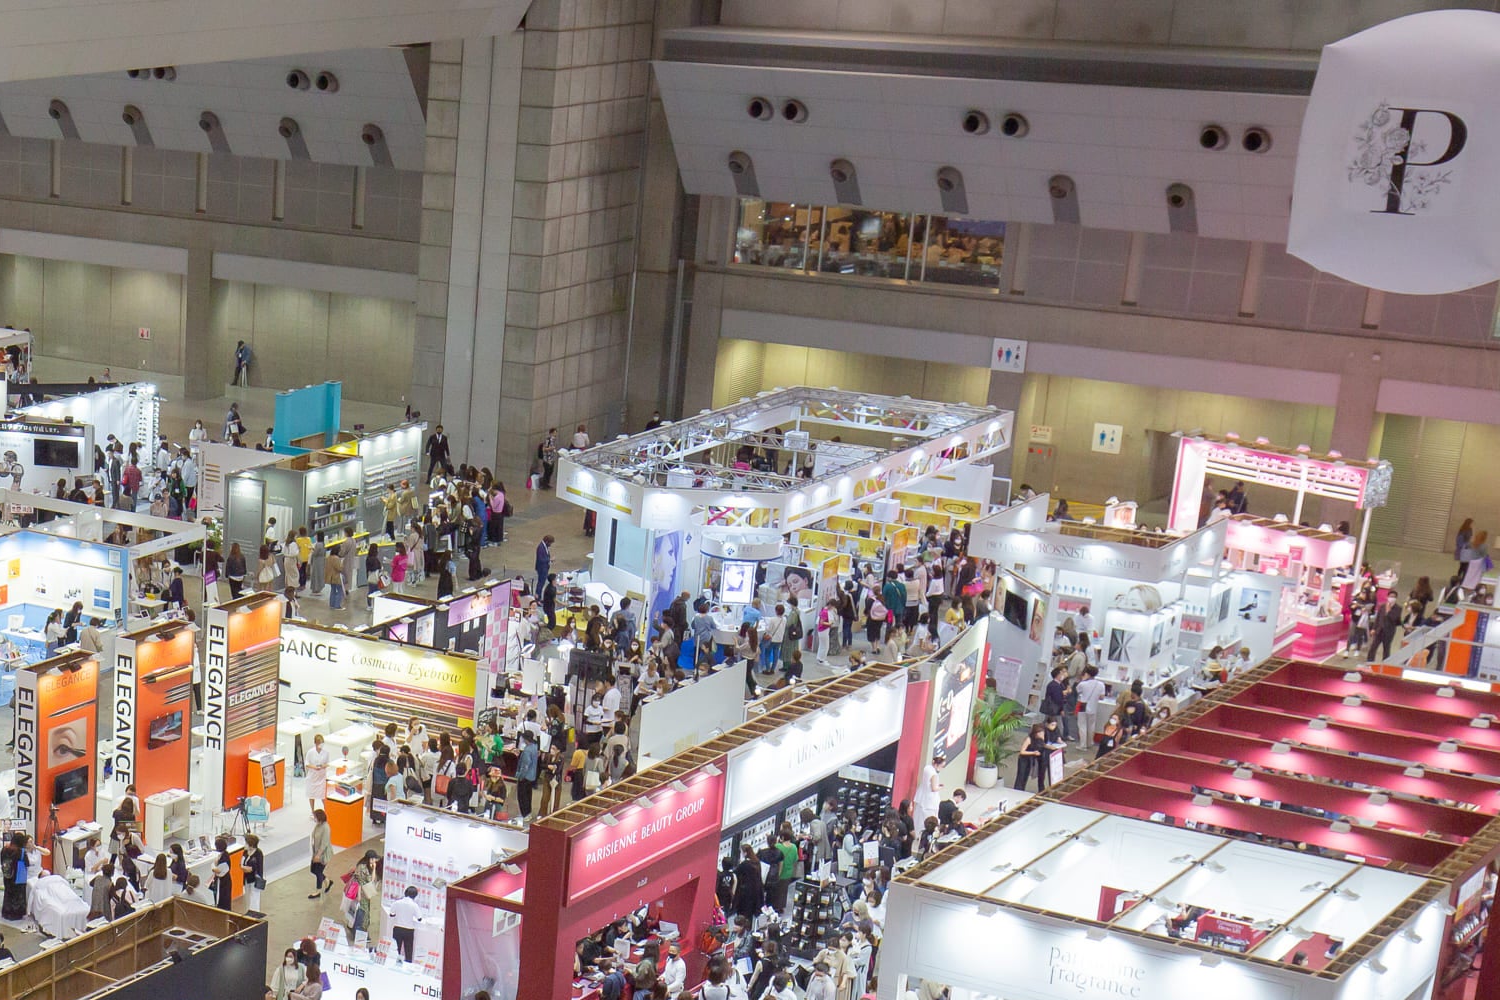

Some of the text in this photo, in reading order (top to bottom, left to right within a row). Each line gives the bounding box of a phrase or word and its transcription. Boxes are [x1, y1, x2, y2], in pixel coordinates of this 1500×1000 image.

[351, 653, 407, 673] Cosmetic
[206, 624, 225, 751] ELEGANCE
[229, 681, 276, 706] ELEGANCE
[115, 653, 134, 784] ELEGANCE
[16, 686, 35, 822] ELEGANCE
[407, 826, 442, 843] rubis
[585, 798, 705, 867] PARISIENNE BEAUTY GROUP
[333, 961, 365, 979] rubis
[1050, 966, 1141, 997] fragrance
